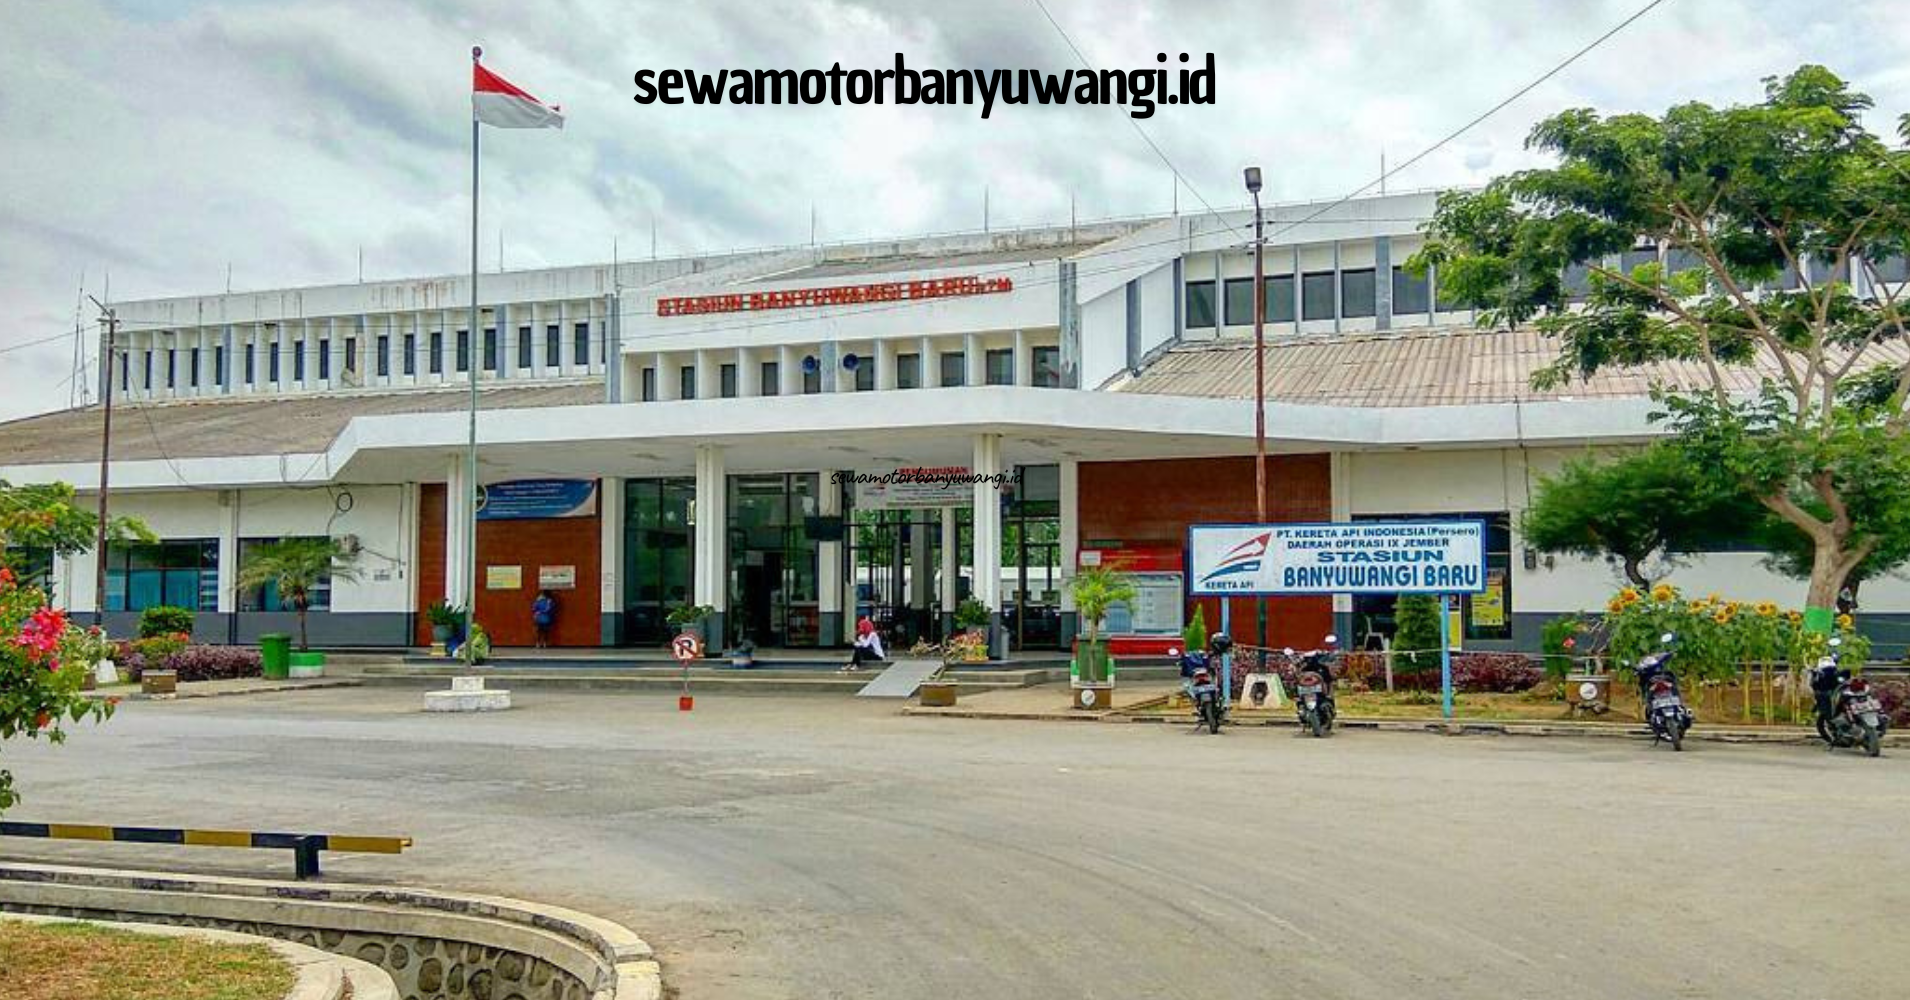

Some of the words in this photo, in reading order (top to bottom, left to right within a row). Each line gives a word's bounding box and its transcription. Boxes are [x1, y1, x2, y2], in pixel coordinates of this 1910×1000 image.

[657, 294, 744, 317] STASIUN
[750, 283, 900, 312] BANYUWANGI
[909, 276, 978, 300] BARU
[1276, 529, 1292, 538] PT.
[1295, 529, 1338, 538] KERETA
[1341, 528, 1360, 537] API
[1363, 527, 1427, 537] INDONESIA
[1427, 526, 1479, 537] (Persero)
[1287, 540, 1332, 549] DAERAH
[1335, 539, 1384, 549] OPERASI
[1388, 539, 1400, 548] IX
[1403, 538, 1450, 548] JEMBER
[1317, 550, 1444, 563] STASIUN
[1284, 565, 1417, 587] BANYUWANGI
[1423, 564, 1478, 587] BARU
[1205, 581, 1238, 590] KERETA
[1240, 581, 1254, 589] API
